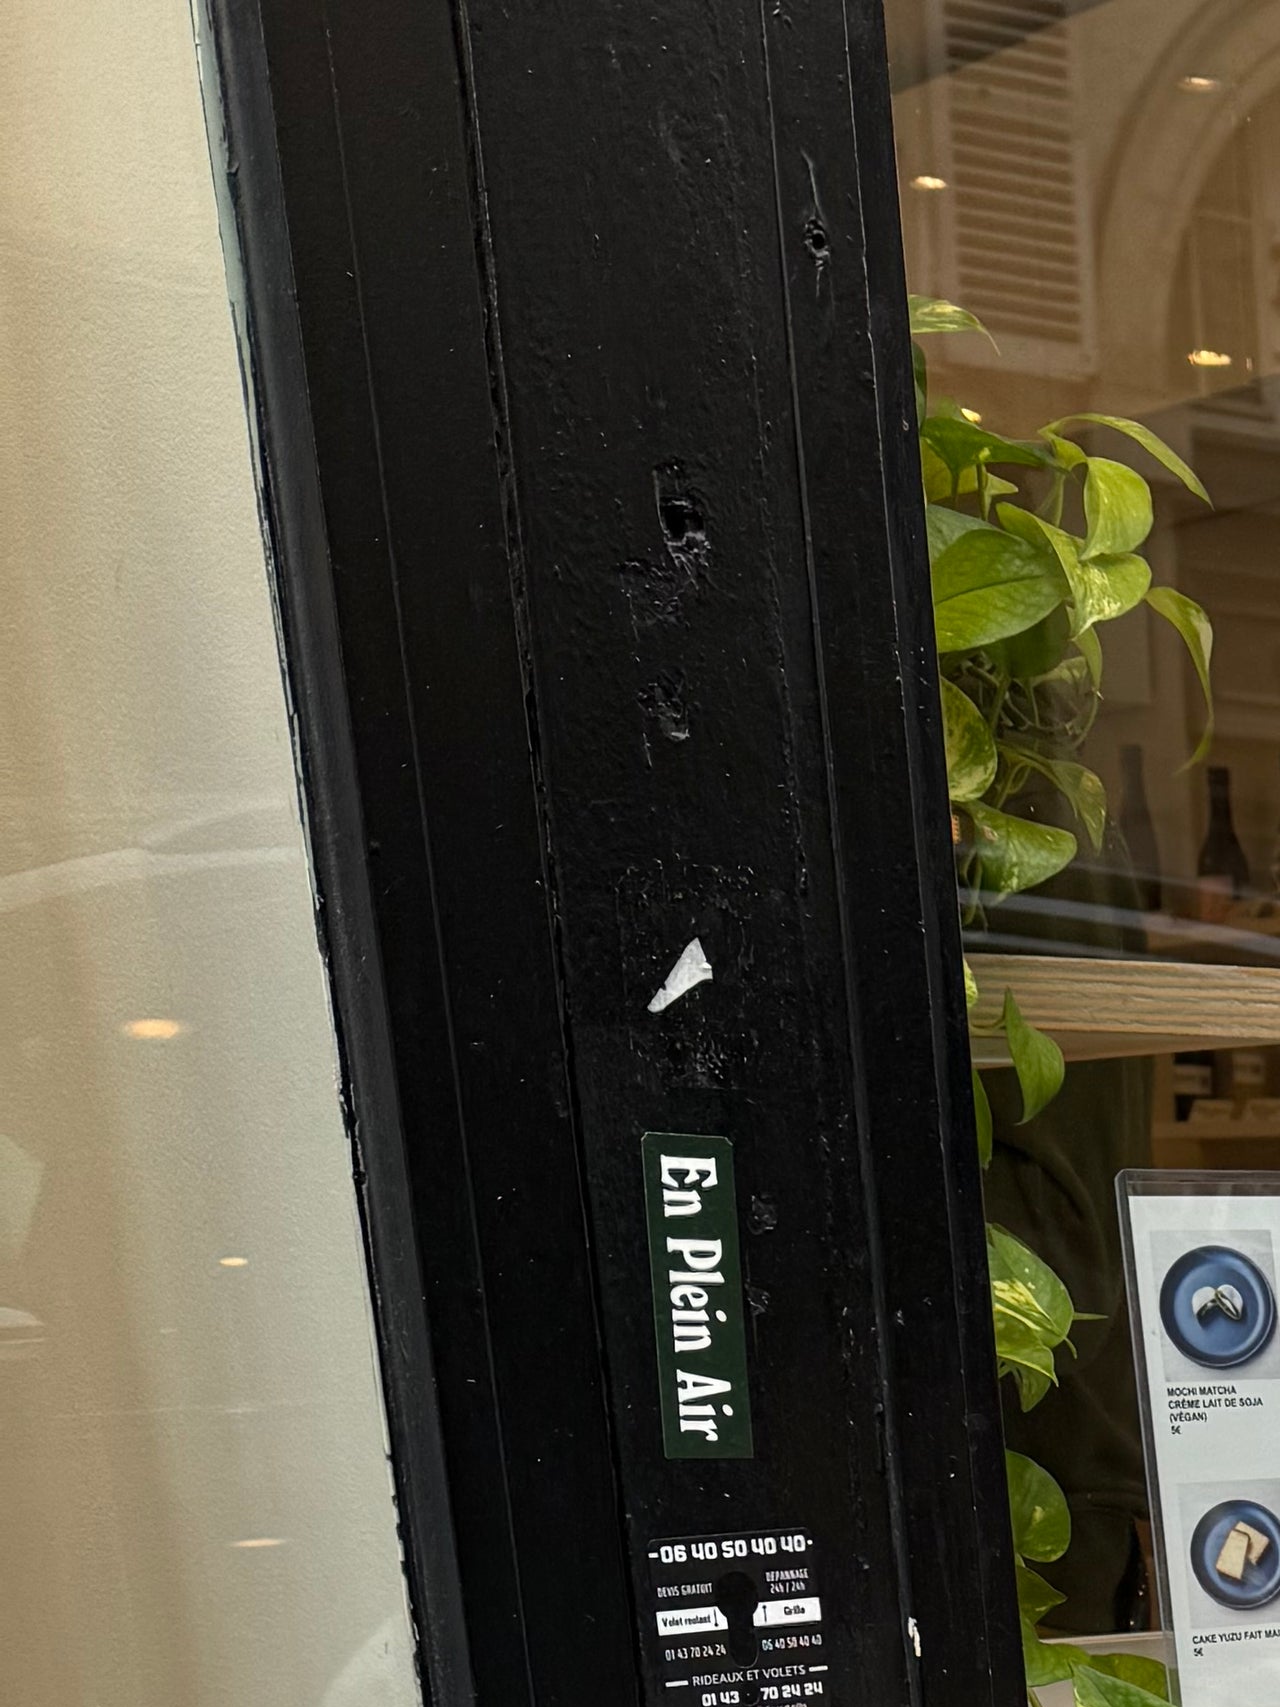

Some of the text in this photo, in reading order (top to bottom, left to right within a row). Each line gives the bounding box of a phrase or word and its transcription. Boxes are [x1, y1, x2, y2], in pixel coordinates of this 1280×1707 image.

[660, 1154, 734, 1442] En Plein Air
[1203, 1398, 1222, 1409] LAIT
[1224, 1397, 1237, 1407] DE
[691, 1541, 718, 1560] 40
[721, 1539, 748, 1558] 50
[750, 1537, 777, 1556] 40
[692, 1665, 806, 1687] RIDEAUX ET VOLETS
[702, 1681, 823, 1707] 01 43 70 24 24
